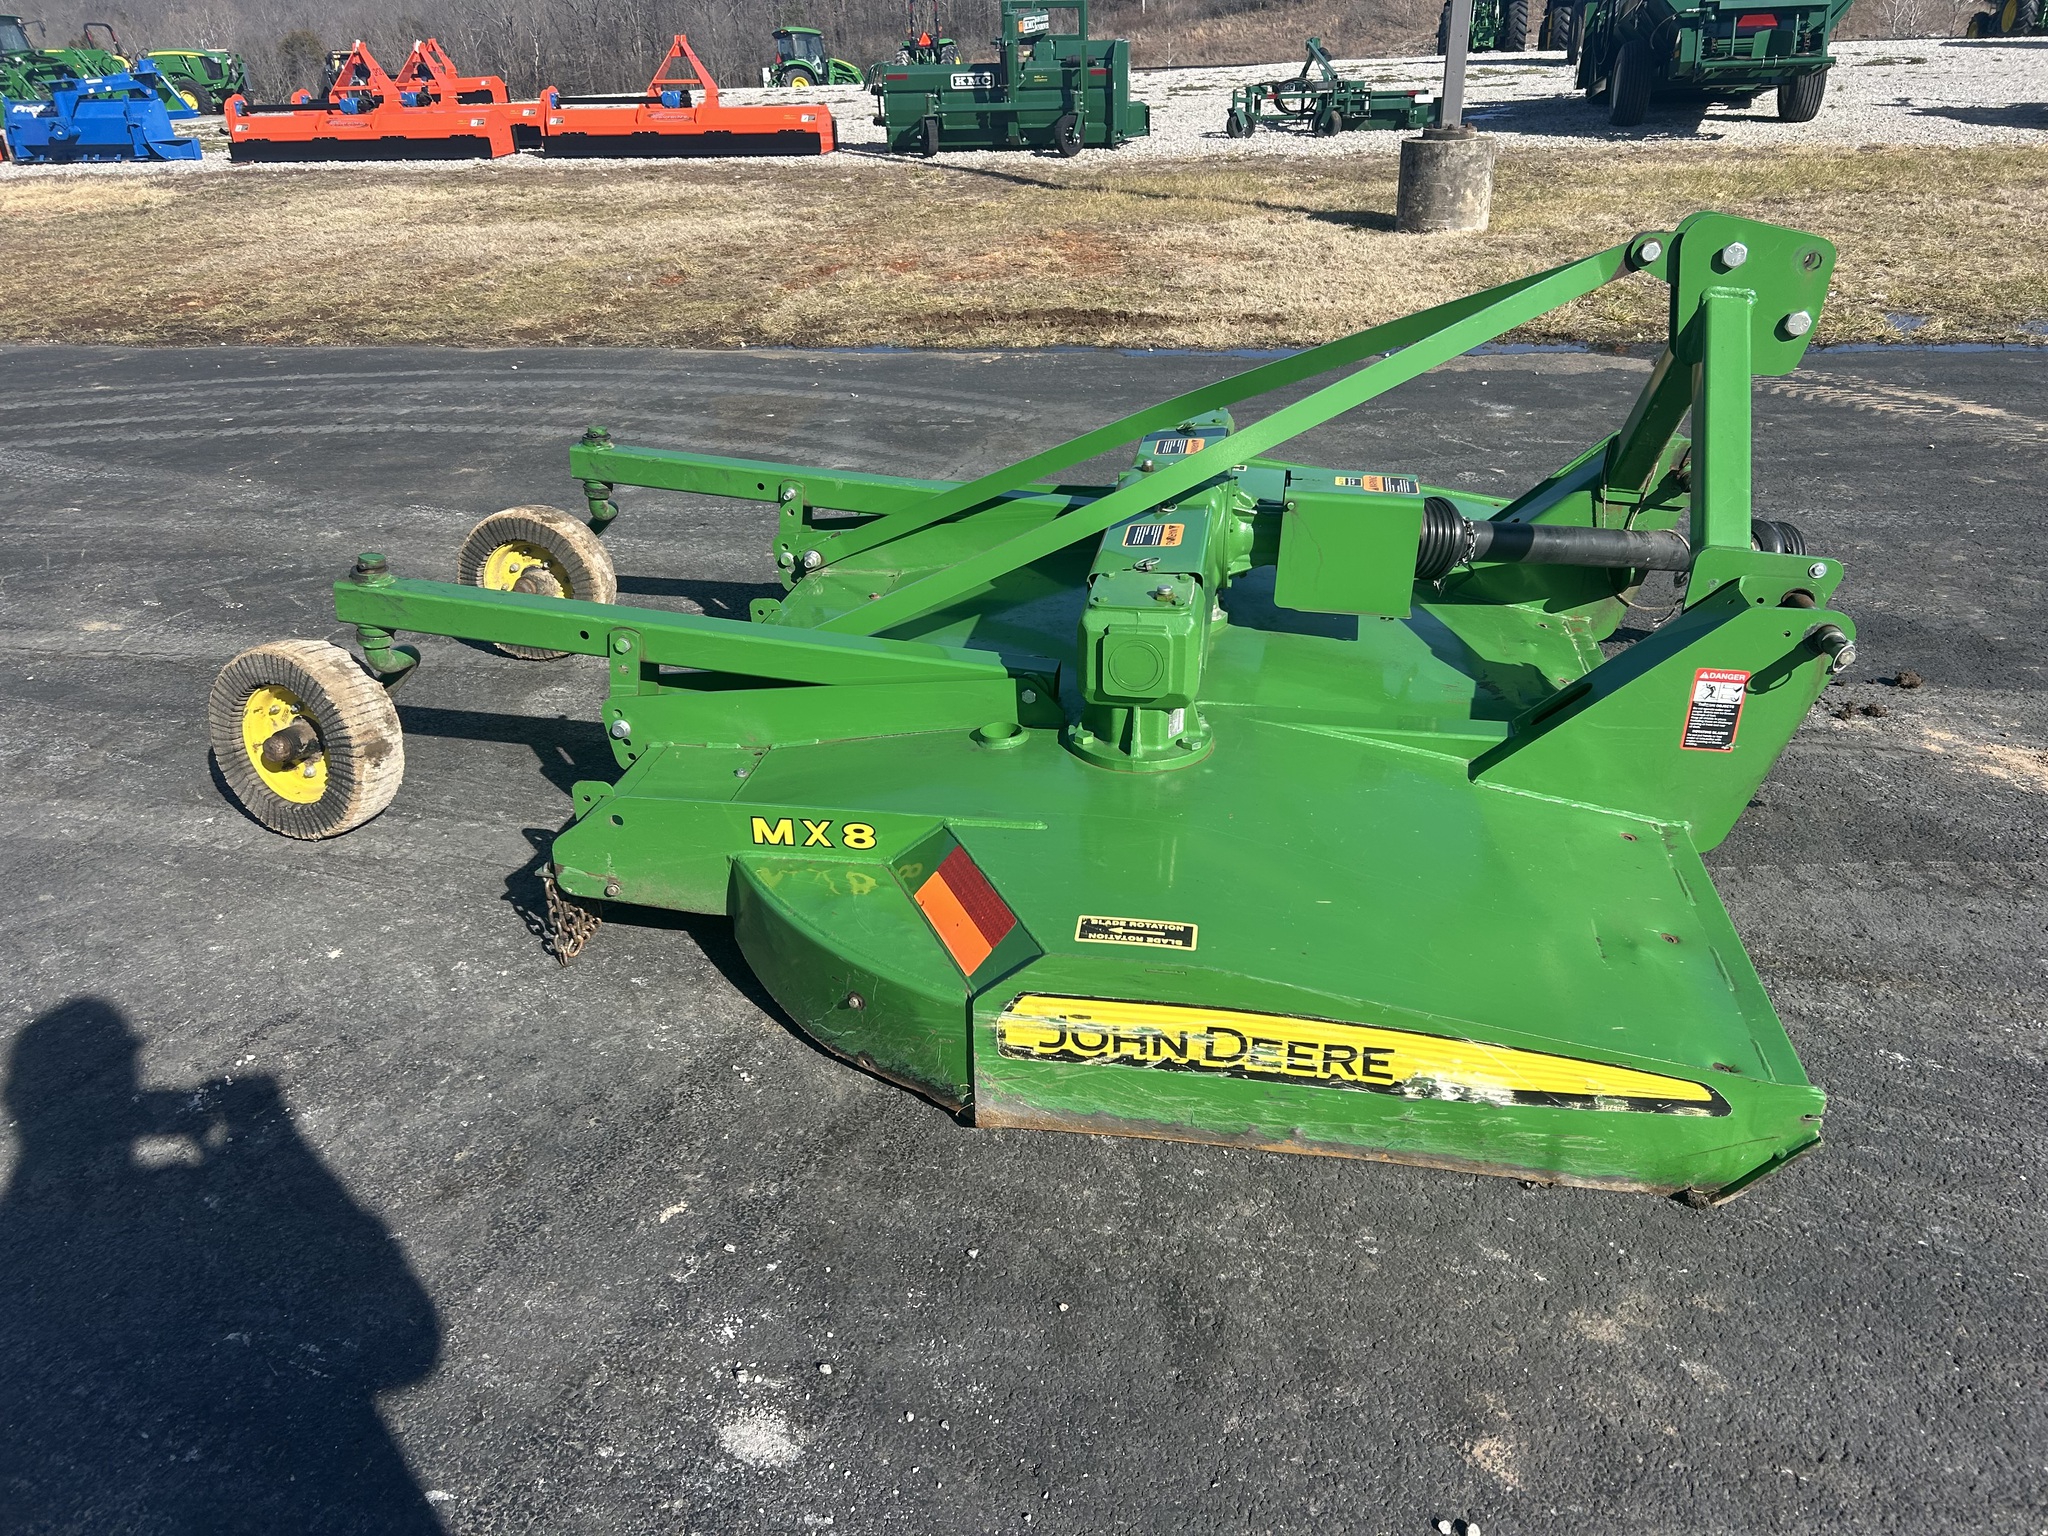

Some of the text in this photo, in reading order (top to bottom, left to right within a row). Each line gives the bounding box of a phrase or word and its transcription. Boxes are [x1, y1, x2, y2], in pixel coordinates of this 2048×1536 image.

[954, 76, 991, 86] KMC
[1709, 672, 1746, 681] DANGER
[1090, 918, 1185, 932] BLADE ROTATION
[1088, 932, 1183, 946] BLADE ROTATION
[1038, 1014, 1396, 1081] JOHN DEERE
